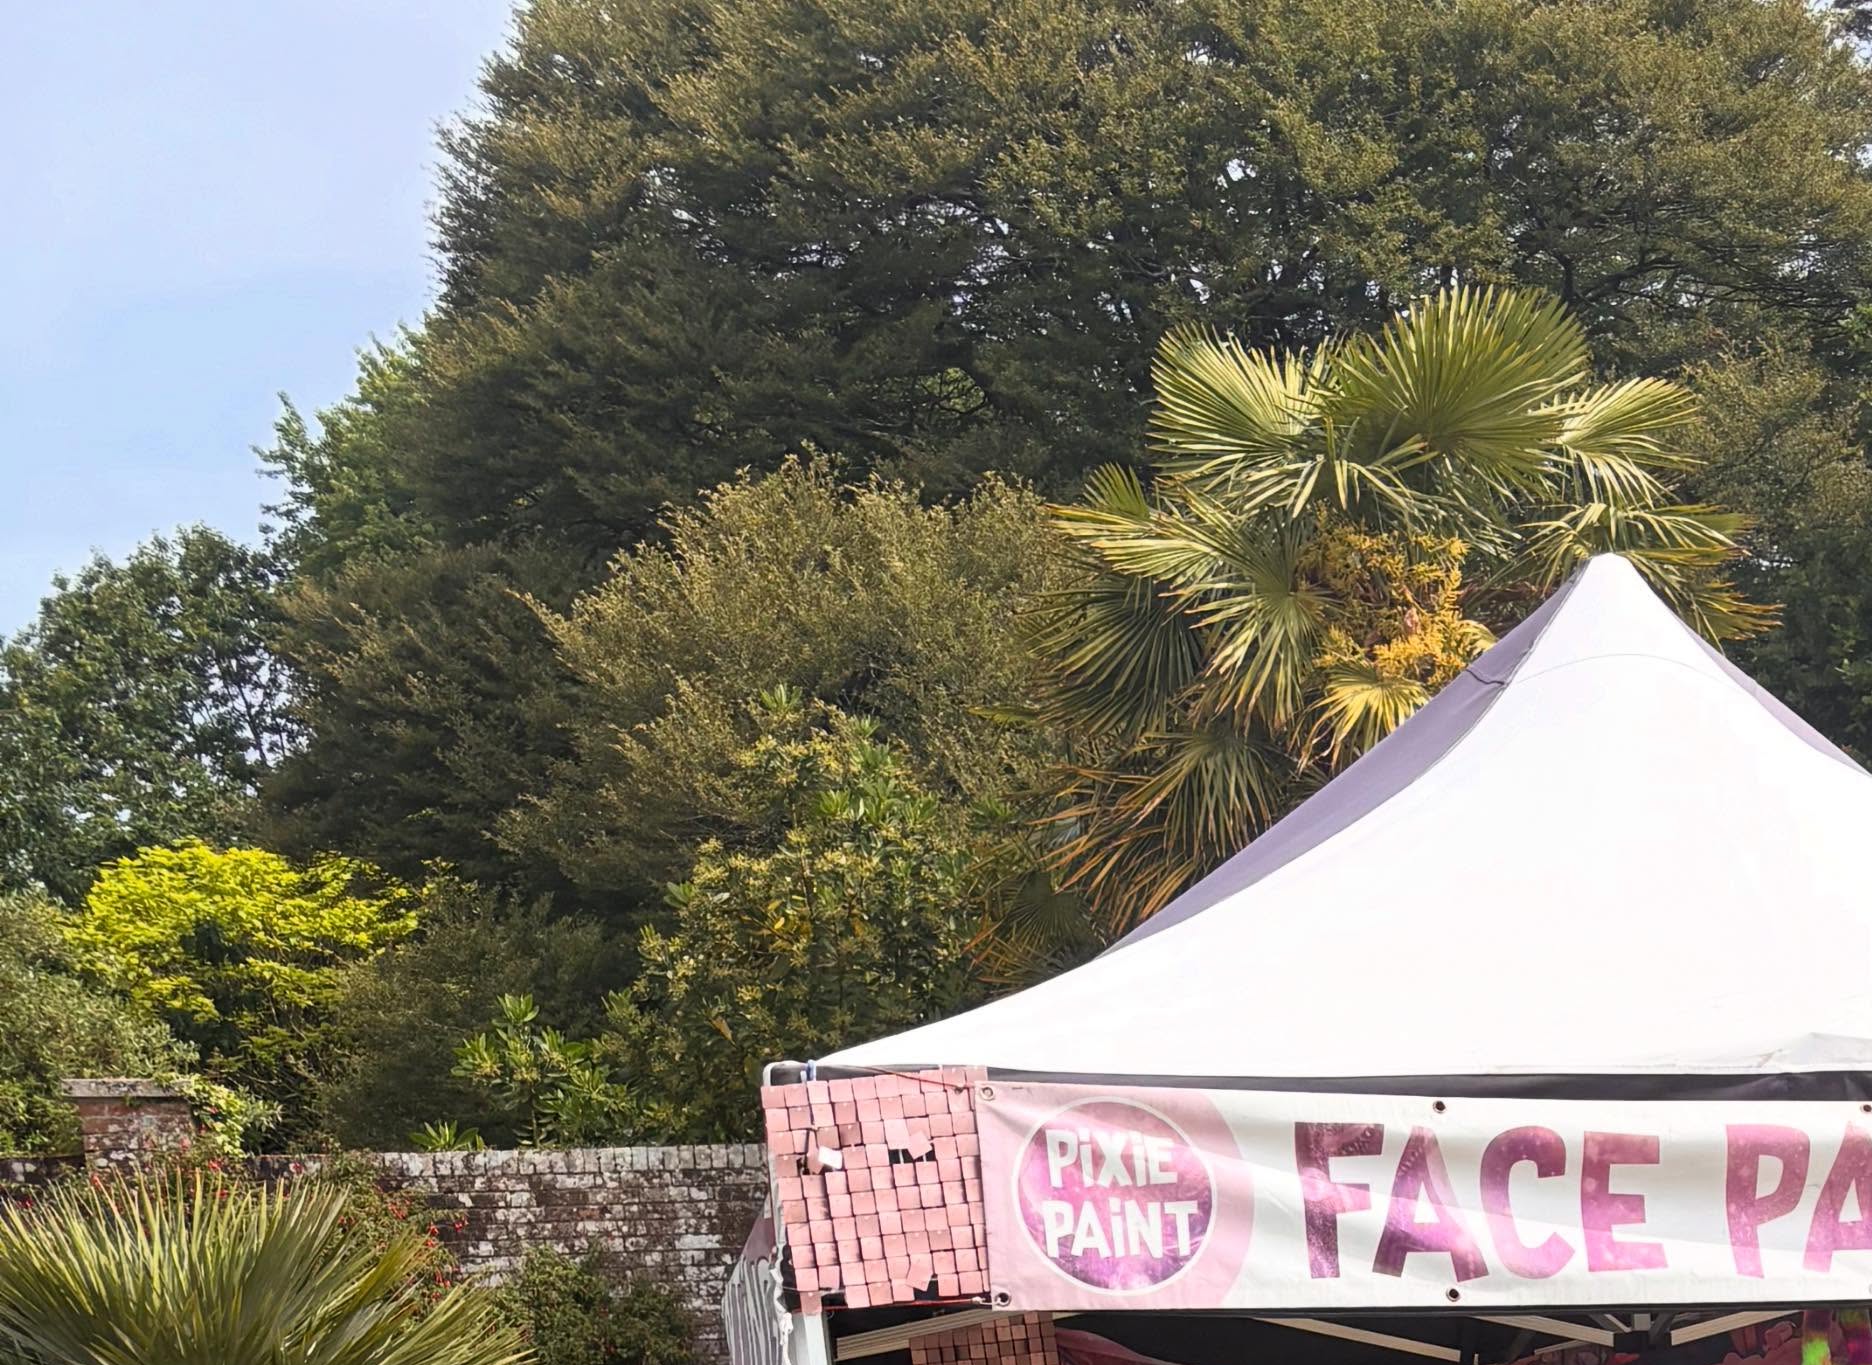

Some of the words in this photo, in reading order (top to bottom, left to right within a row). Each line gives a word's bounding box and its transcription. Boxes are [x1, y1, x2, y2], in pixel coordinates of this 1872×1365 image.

[1047, 1128, 1179, 1188] PiXiE
[1042, 1197, 1199, 1263] PAiNT
[1293, 1121, 1671, 1284] FACE
